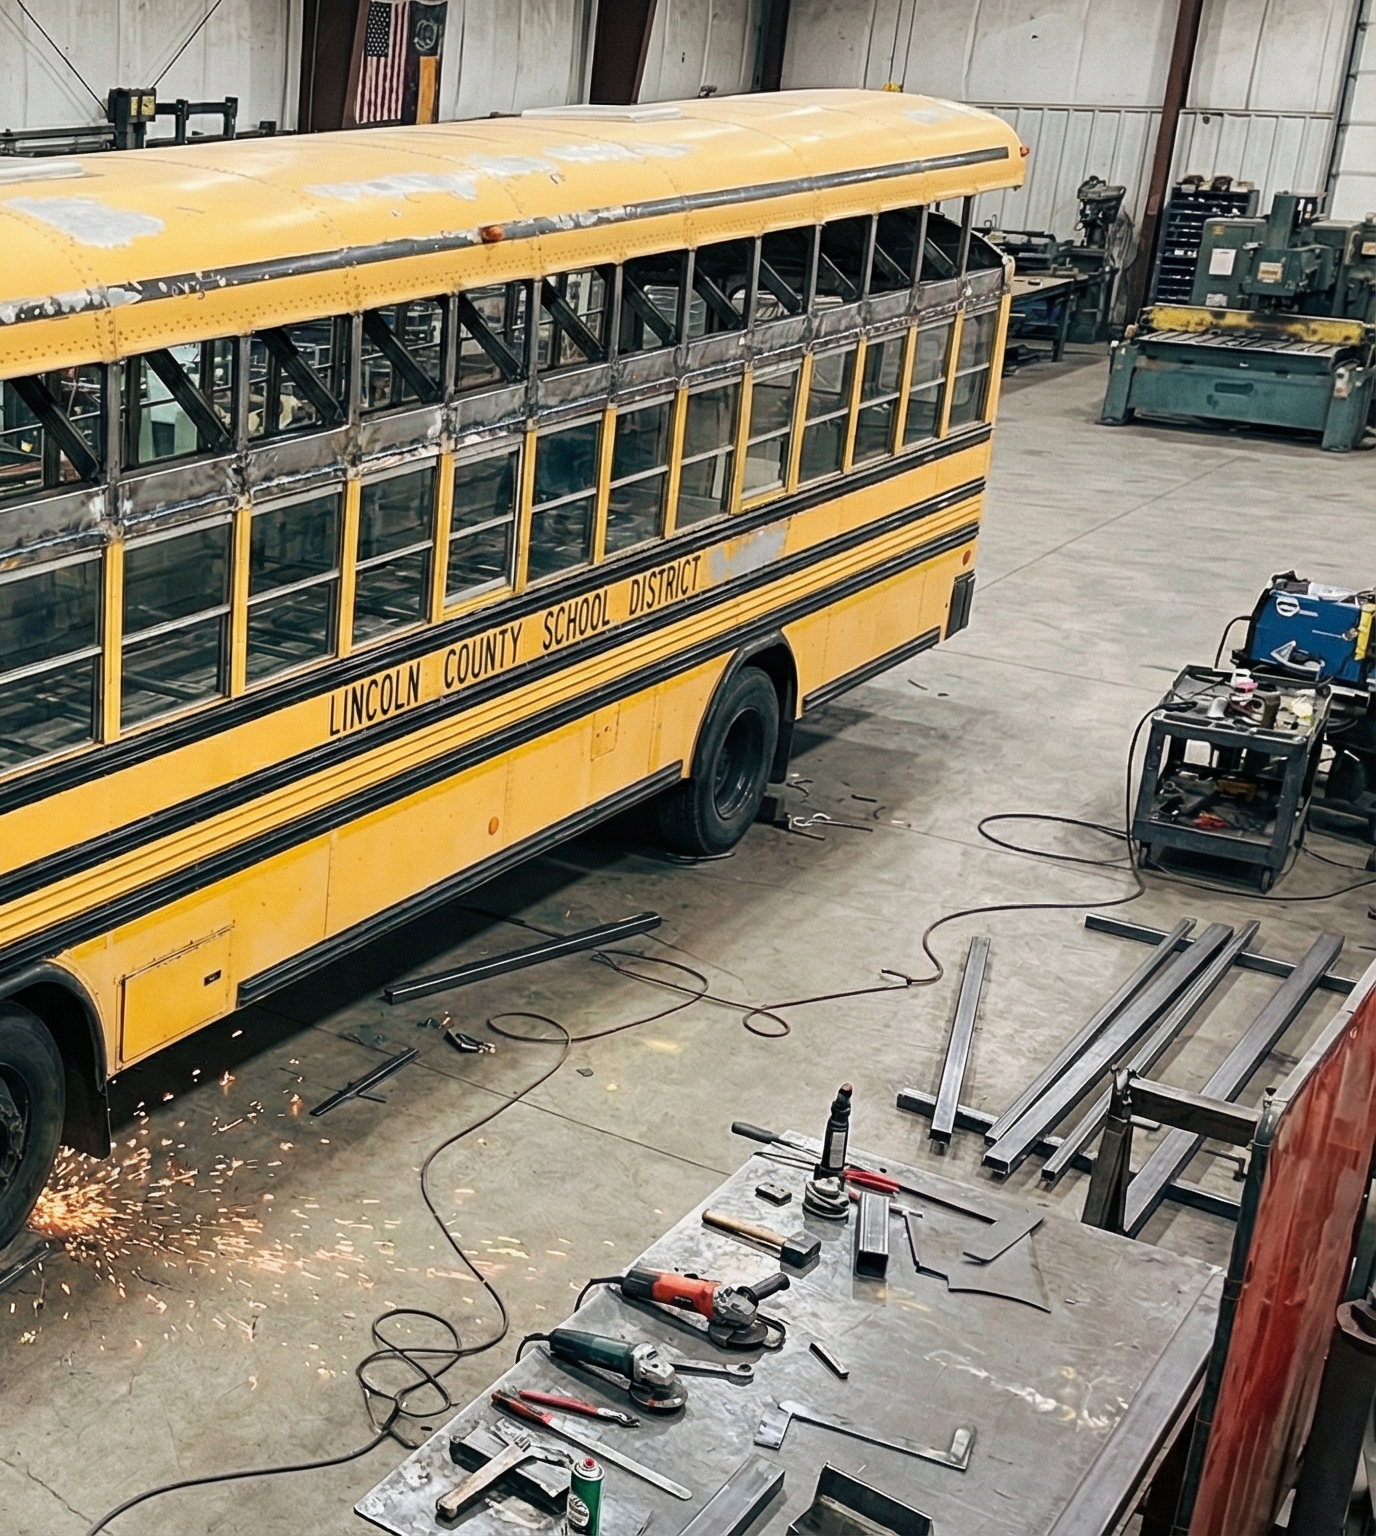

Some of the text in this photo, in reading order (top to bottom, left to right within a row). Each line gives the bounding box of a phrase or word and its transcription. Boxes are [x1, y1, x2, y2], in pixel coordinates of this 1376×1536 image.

[329, 555, 702, 736] LINCOLN COUNTY SCHOOL DISTRICT
